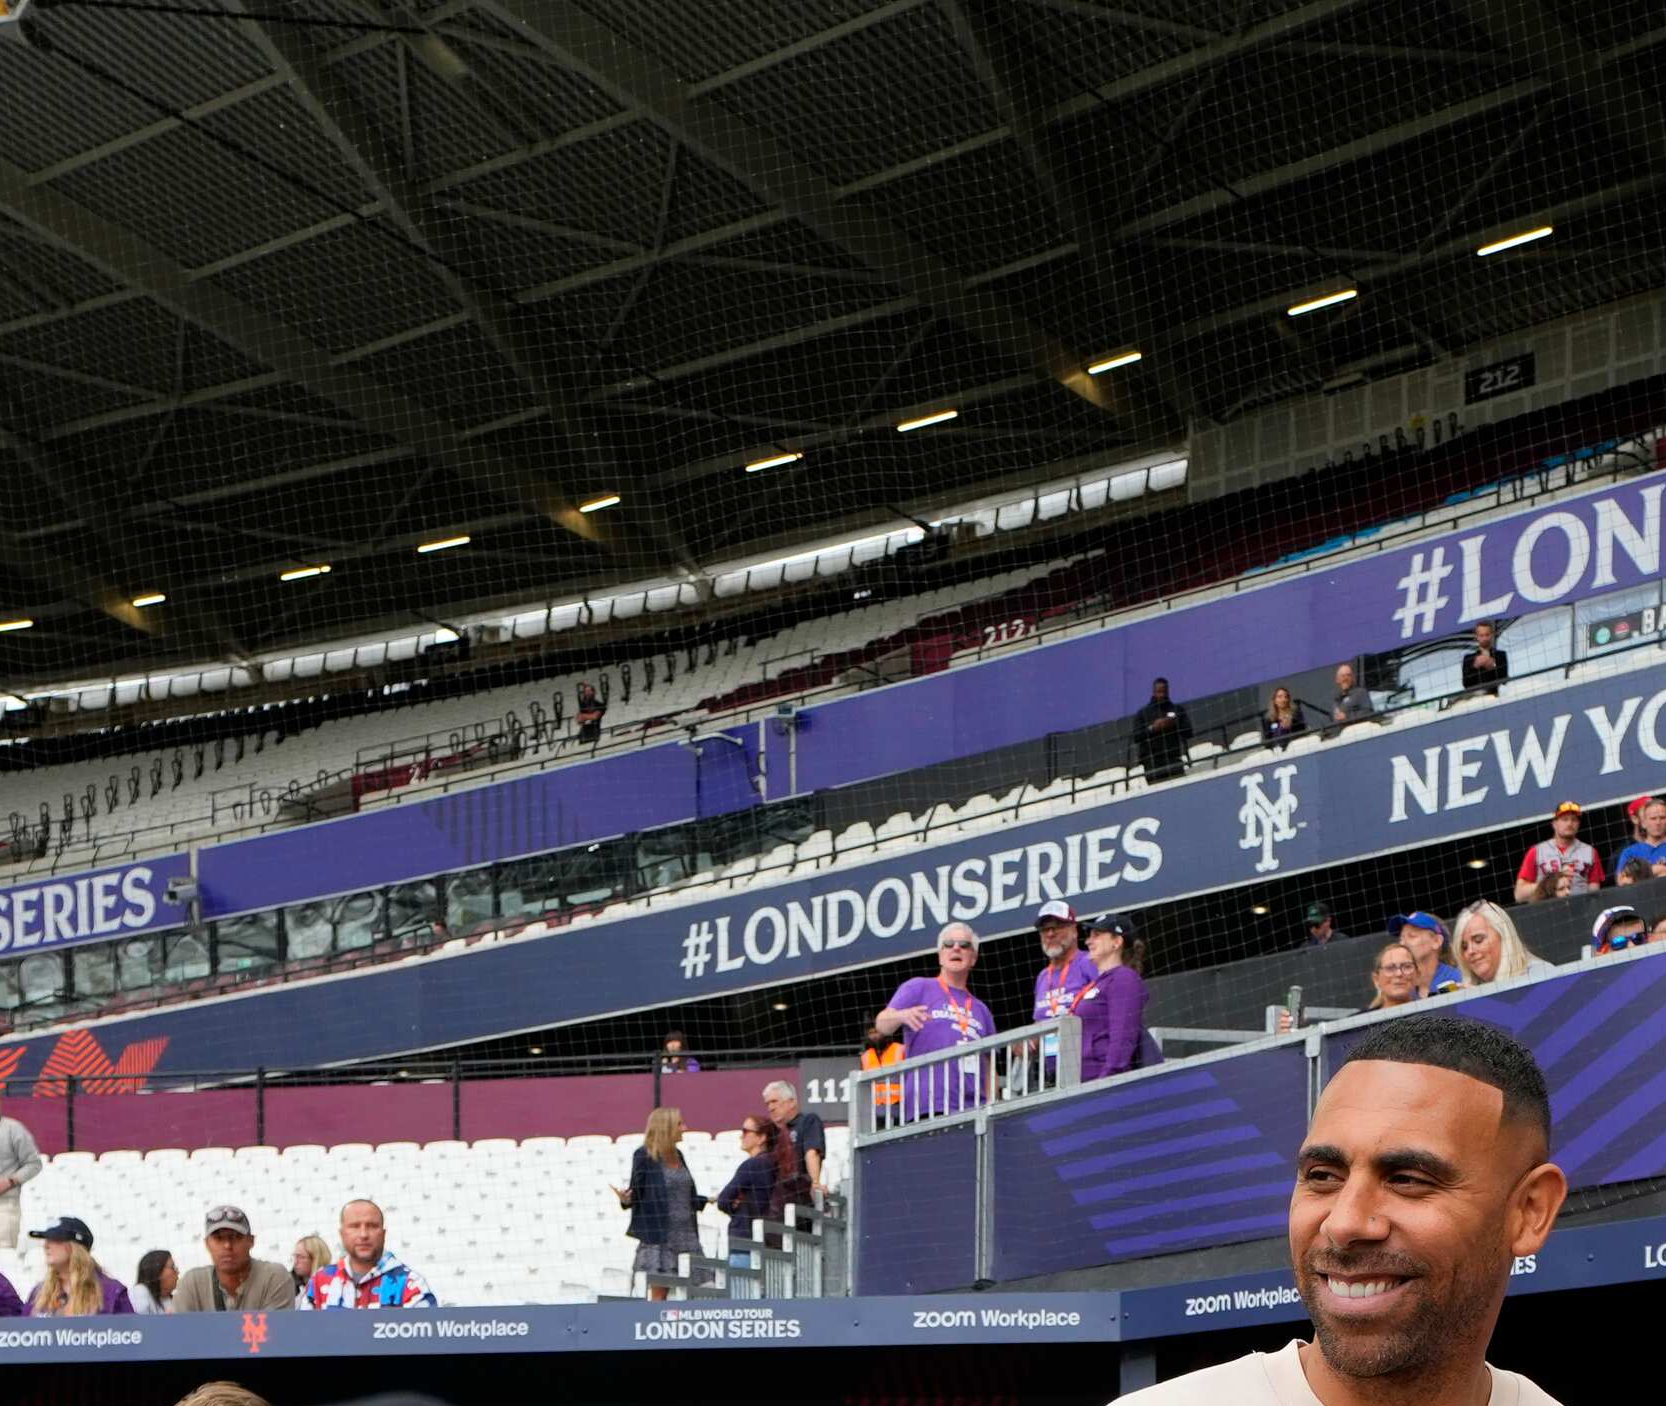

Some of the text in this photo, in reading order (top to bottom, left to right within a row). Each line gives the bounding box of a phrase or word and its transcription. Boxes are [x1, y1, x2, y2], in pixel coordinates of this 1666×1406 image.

[1390, 713, 1573, 824] NEW
[680, 817, 1163, 980] #LONDONSERIES
[1185, 1286, 1302, 1316] zoom Workplac
[678, 1309, 773, 1321] MLB WORLD TOUR
[913, 1309, 1081, 1330] zoom Workplace
[55, 1329, 142, 1349] Workplace
[373, 1320, 529, 1340] zoom Workplace
[635, 1319, 802, 1341] LONDON SERIES
